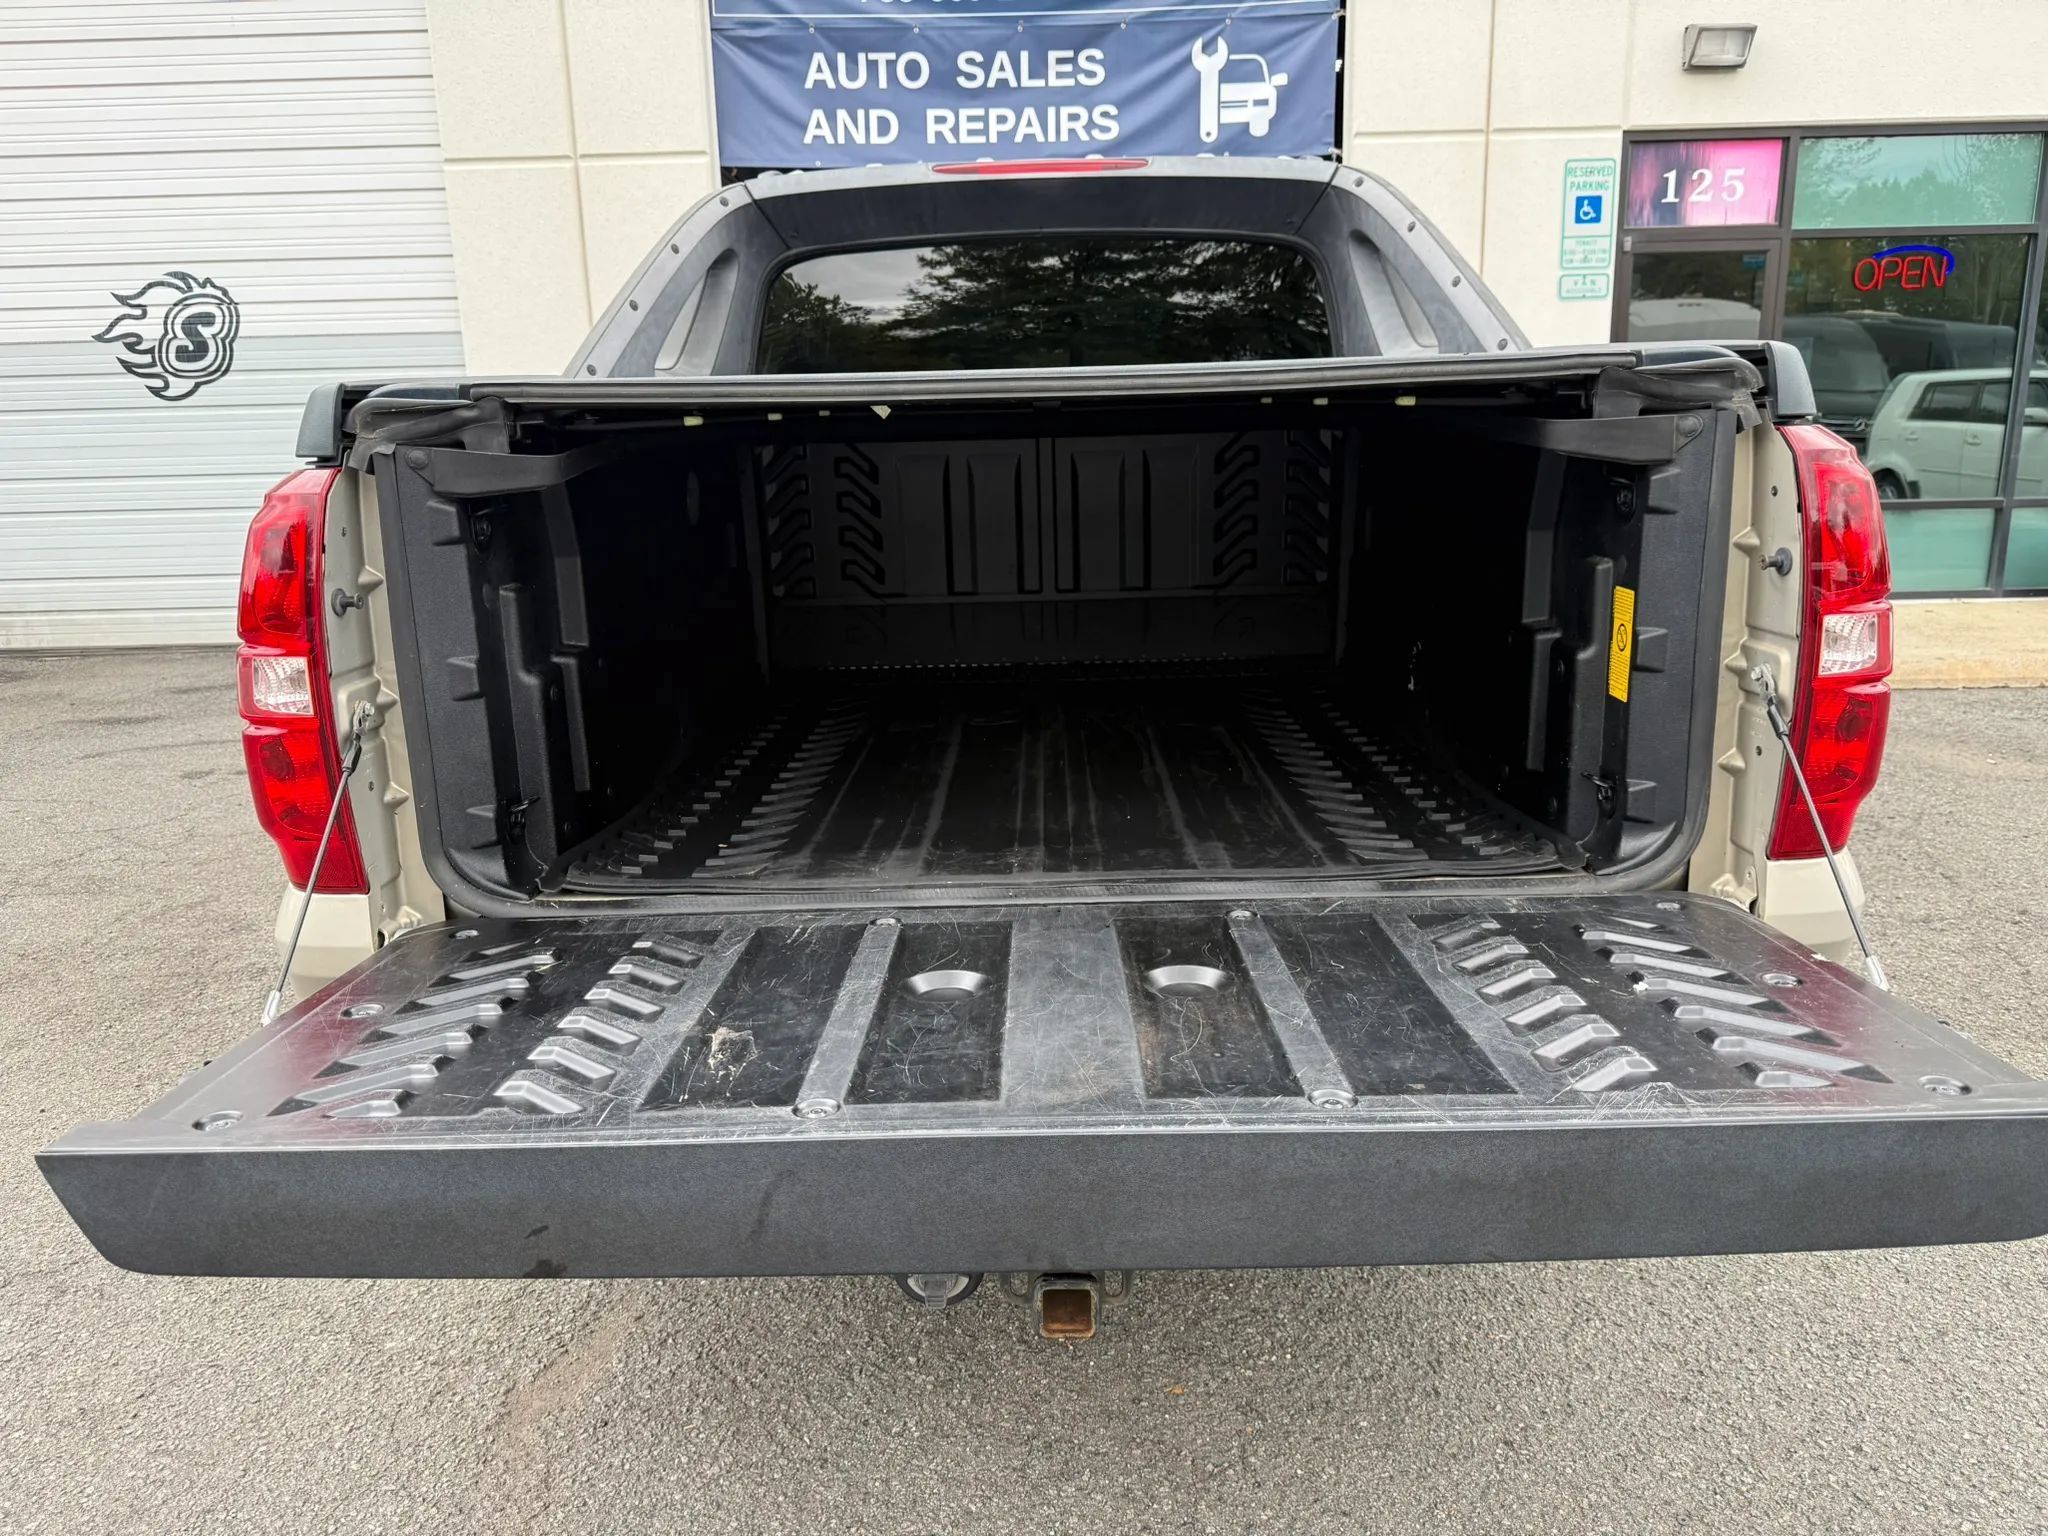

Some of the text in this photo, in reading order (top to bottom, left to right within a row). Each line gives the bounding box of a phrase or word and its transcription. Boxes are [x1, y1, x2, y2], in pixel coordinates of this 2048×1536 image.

[804, 48, 1106, 90] AUTO SALES
[803, 104, 1120, 145] AND REPAIRS
[1567, 165, 1613, 178] RESERVED
[1569, 180, 1610, 191] PARKING
[1661, 167, 1746, 204] 125
[1854, 256, 1947, 291] OPEN
